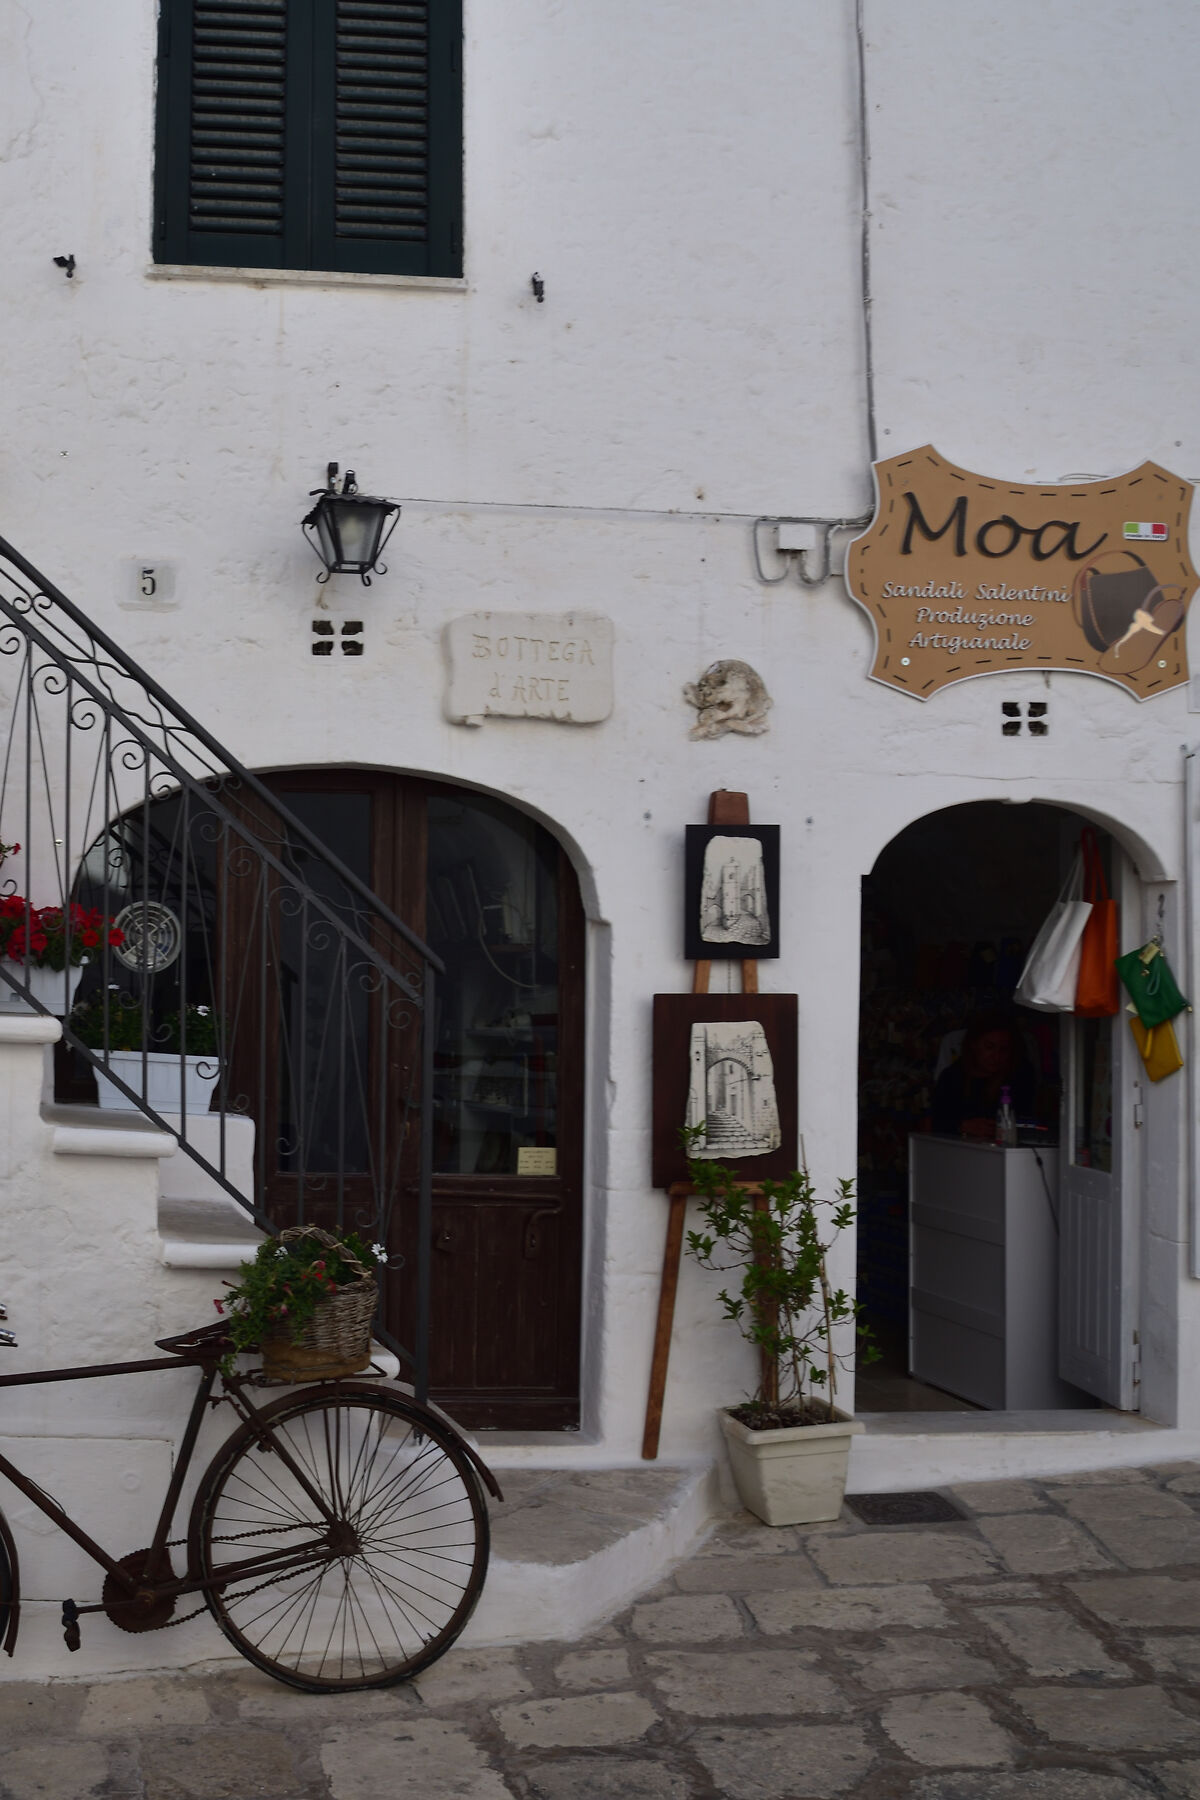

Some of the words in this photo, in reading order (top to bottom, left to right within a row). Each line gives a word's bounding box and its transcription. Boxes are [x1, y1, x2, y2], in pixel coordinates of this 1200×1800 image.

[900, 491, 1108, 561] Moa
[141, 568, 157, 596] 5
[881, 580, 968, 600] Sandali
[974, 583, 1073, 603] Salentini
[915, 606, 1036, 631] Produzione
[471, 632, 596, 666] BOTTEGA
[908, 631, 1033, 655] Artigianale
